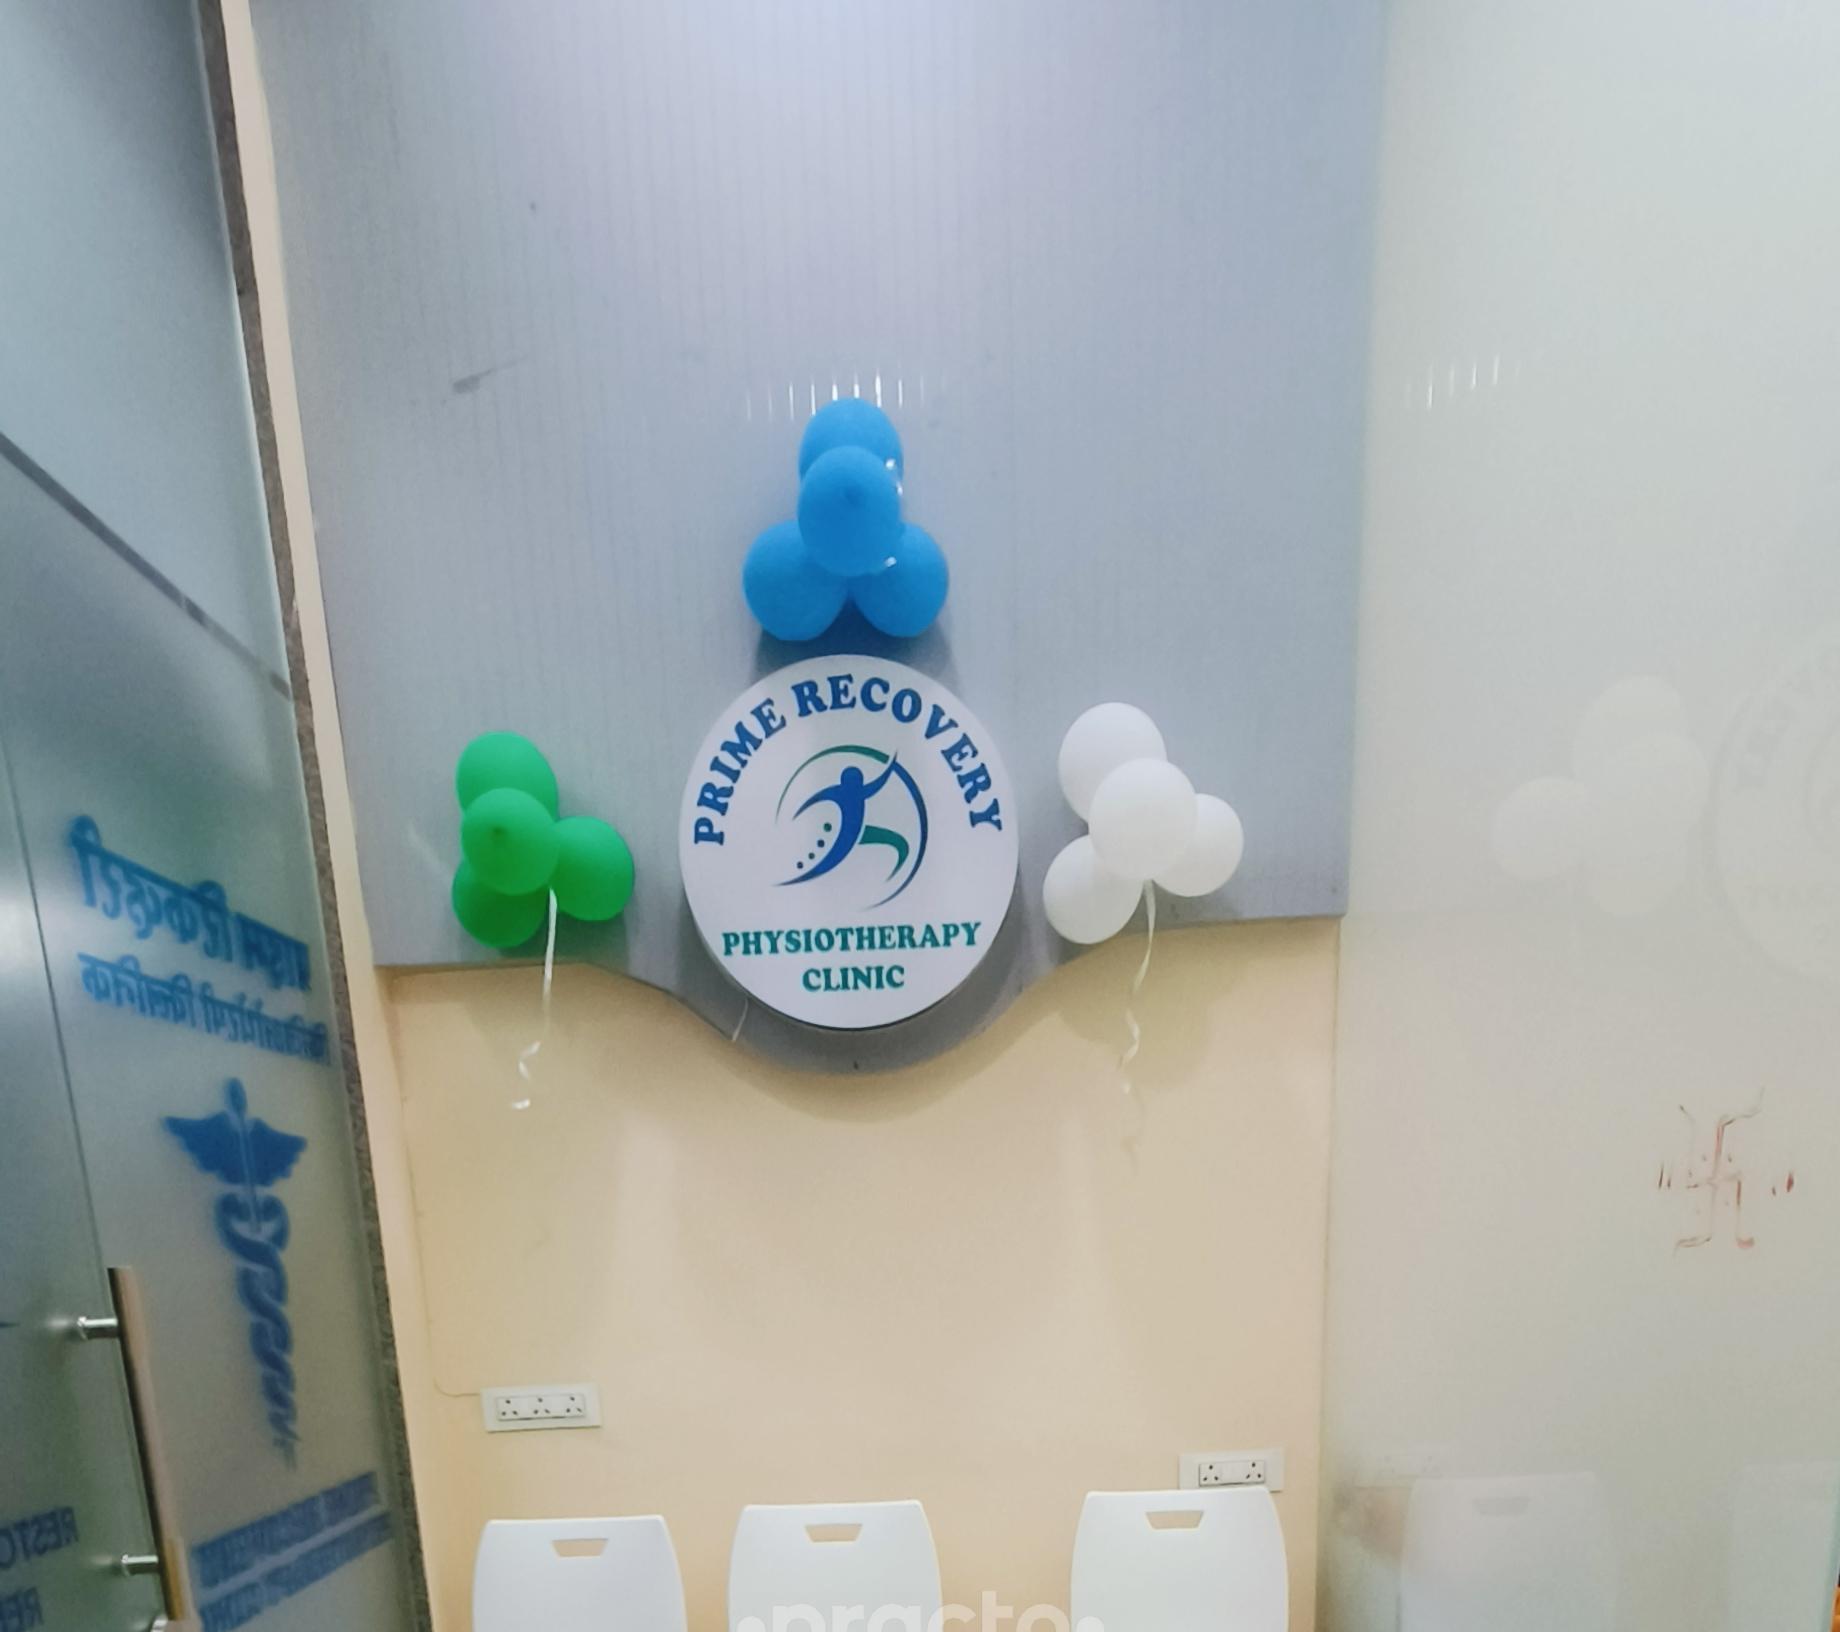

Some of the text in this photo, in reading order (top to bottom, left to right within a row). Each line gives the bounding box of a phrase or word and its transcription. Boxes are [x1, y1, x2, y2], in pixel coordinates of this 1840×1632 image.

[694, 673, 1003, 846] PRIME RECOVERY
[722, 922, 981, 957] PHYSIOTHERAPY
[802, 965, 905, 992] CLINIC
